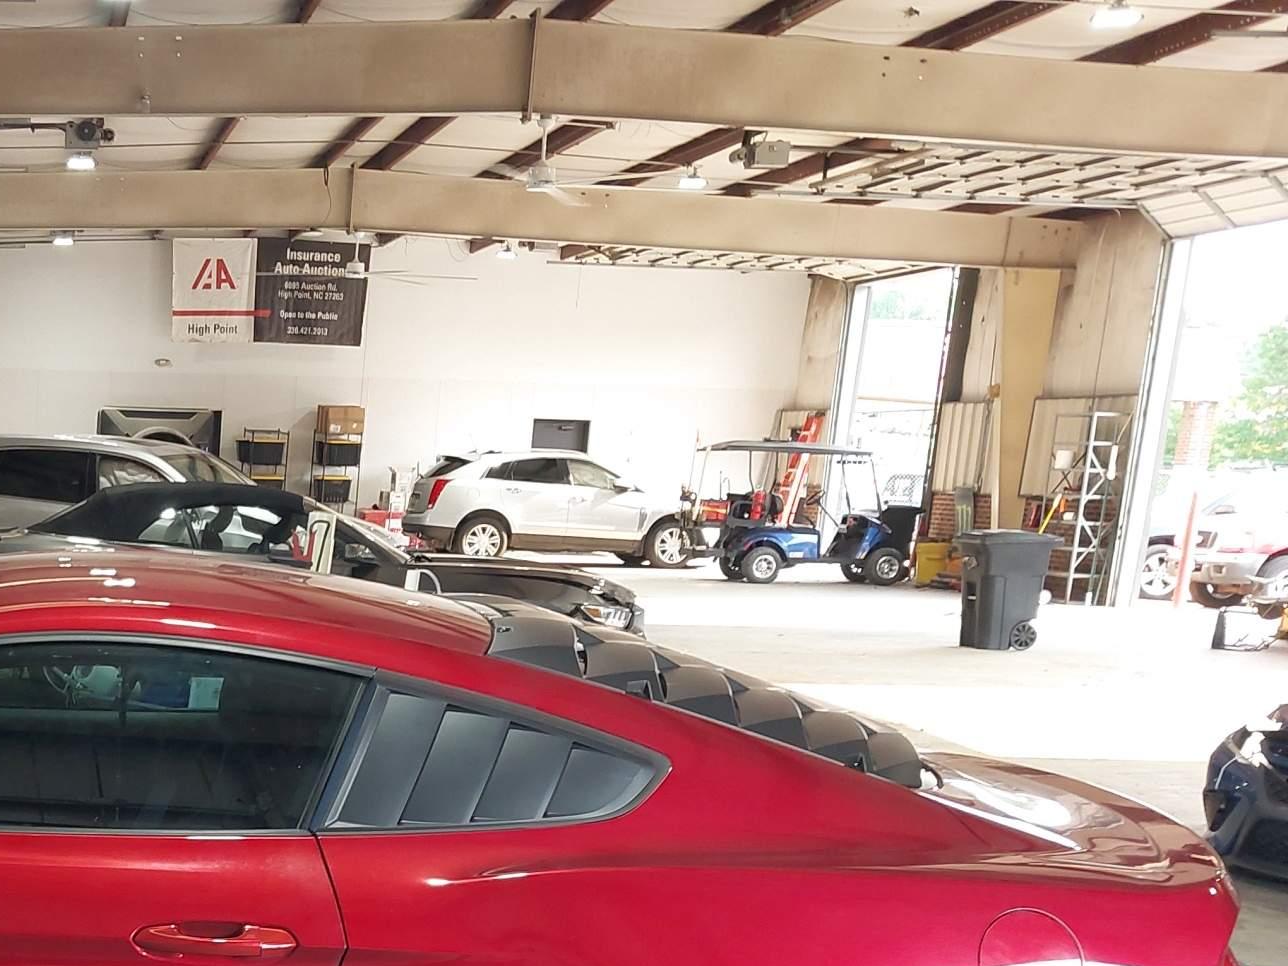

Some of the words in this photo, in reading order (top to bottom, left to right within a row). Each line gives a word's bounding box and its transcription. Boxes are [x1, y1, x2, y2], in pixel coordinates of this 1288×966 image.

[286, 247, 342, 262] Insurance
[274, 261, 300, 275] Auto
[302, 263, 347, 277] Auction
[300, 281, 326, 291] Auction
[327, 282, 338, 292] Rd.
[313, 291, 323, 300] NC
[279, 309, 296, 320] Open
[297, 311, 305, 319] to
[305, 311, 316, 319] the
[317, 311, 338, 321] Public
[187, 323, 210, 337] High
[214, 323, 238, 334] Point
